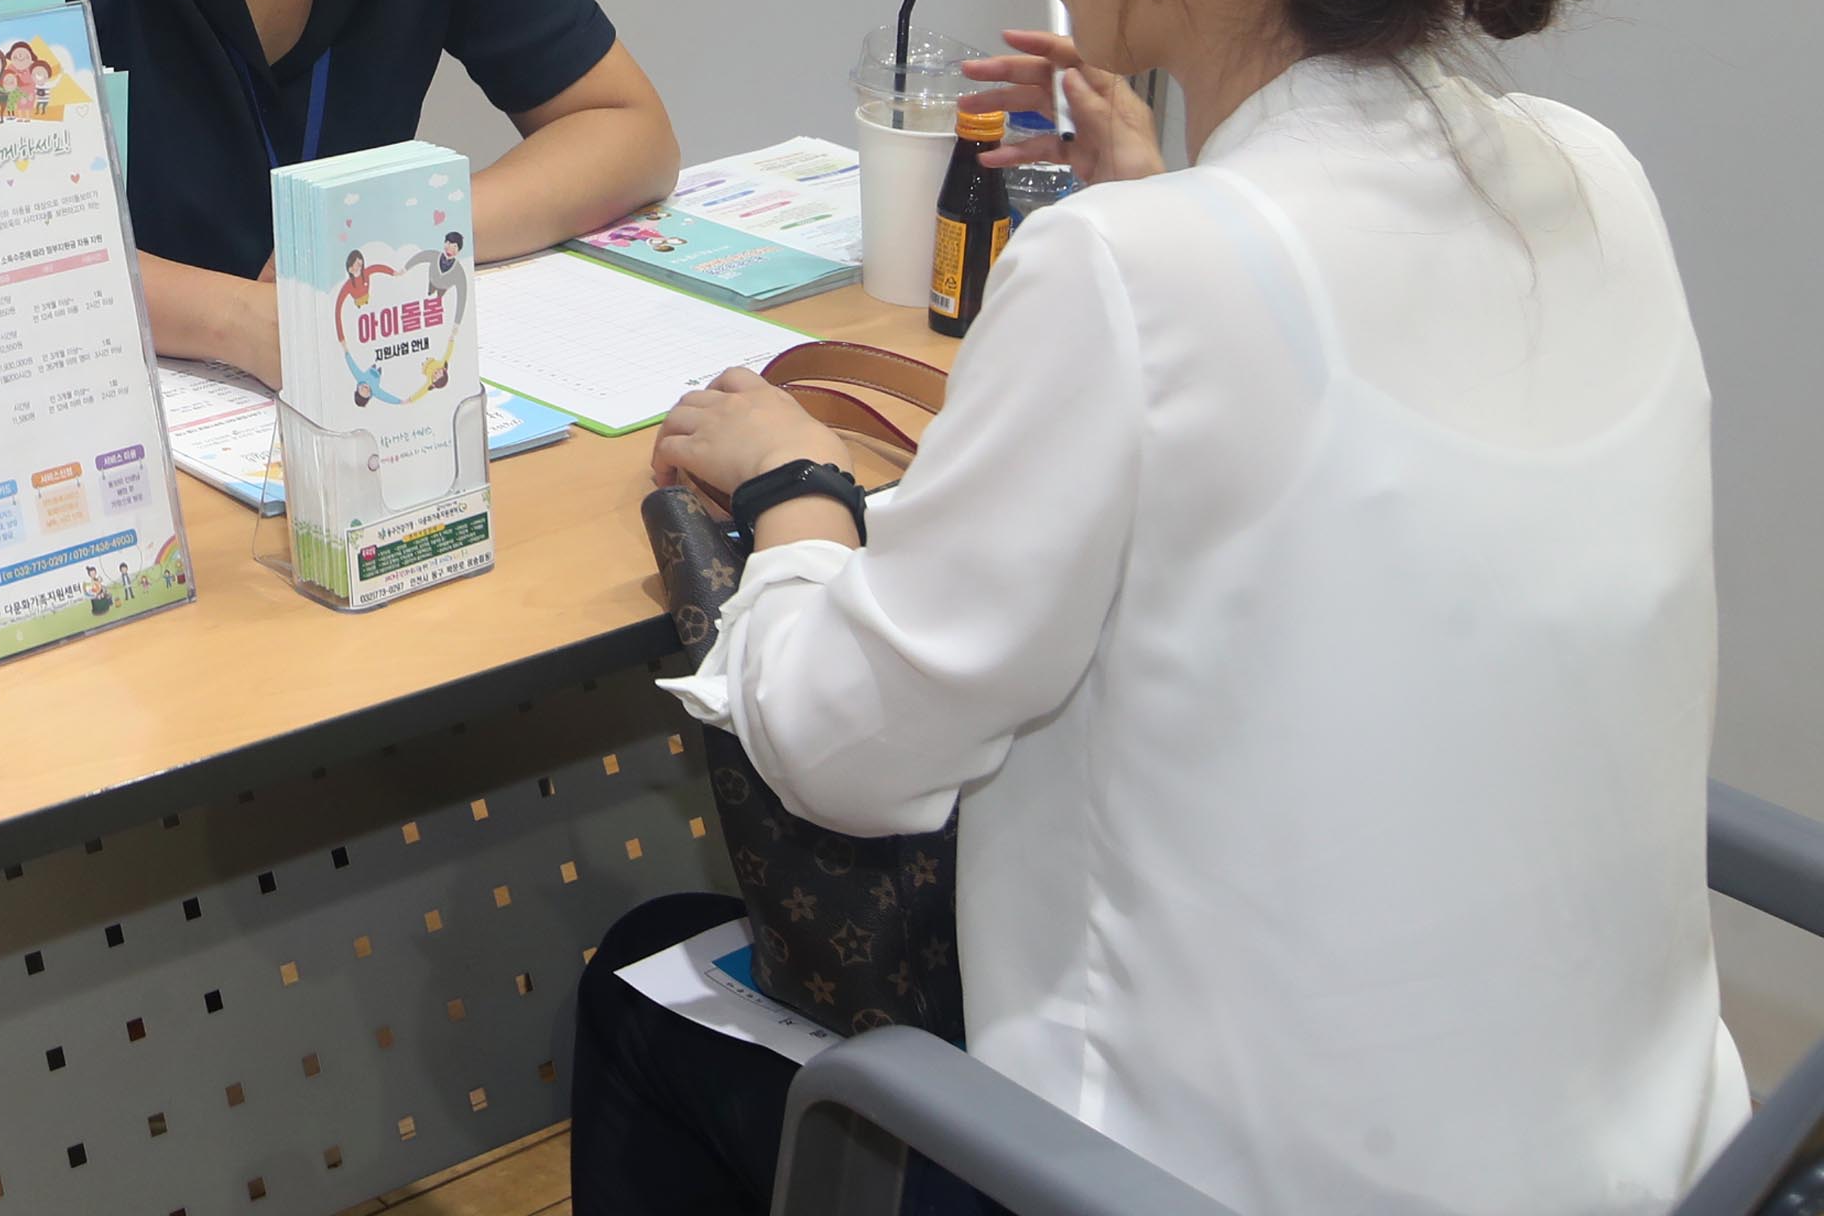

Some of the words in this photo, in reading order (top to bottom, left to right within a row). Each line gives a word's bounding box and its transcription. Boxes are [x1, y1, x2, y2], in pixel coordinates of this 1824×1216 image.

[358, 295, 444, 344] 아이돌봄
[375, 341, 409, 362] 지원사업
[411, 337, 430, 353] 안내
